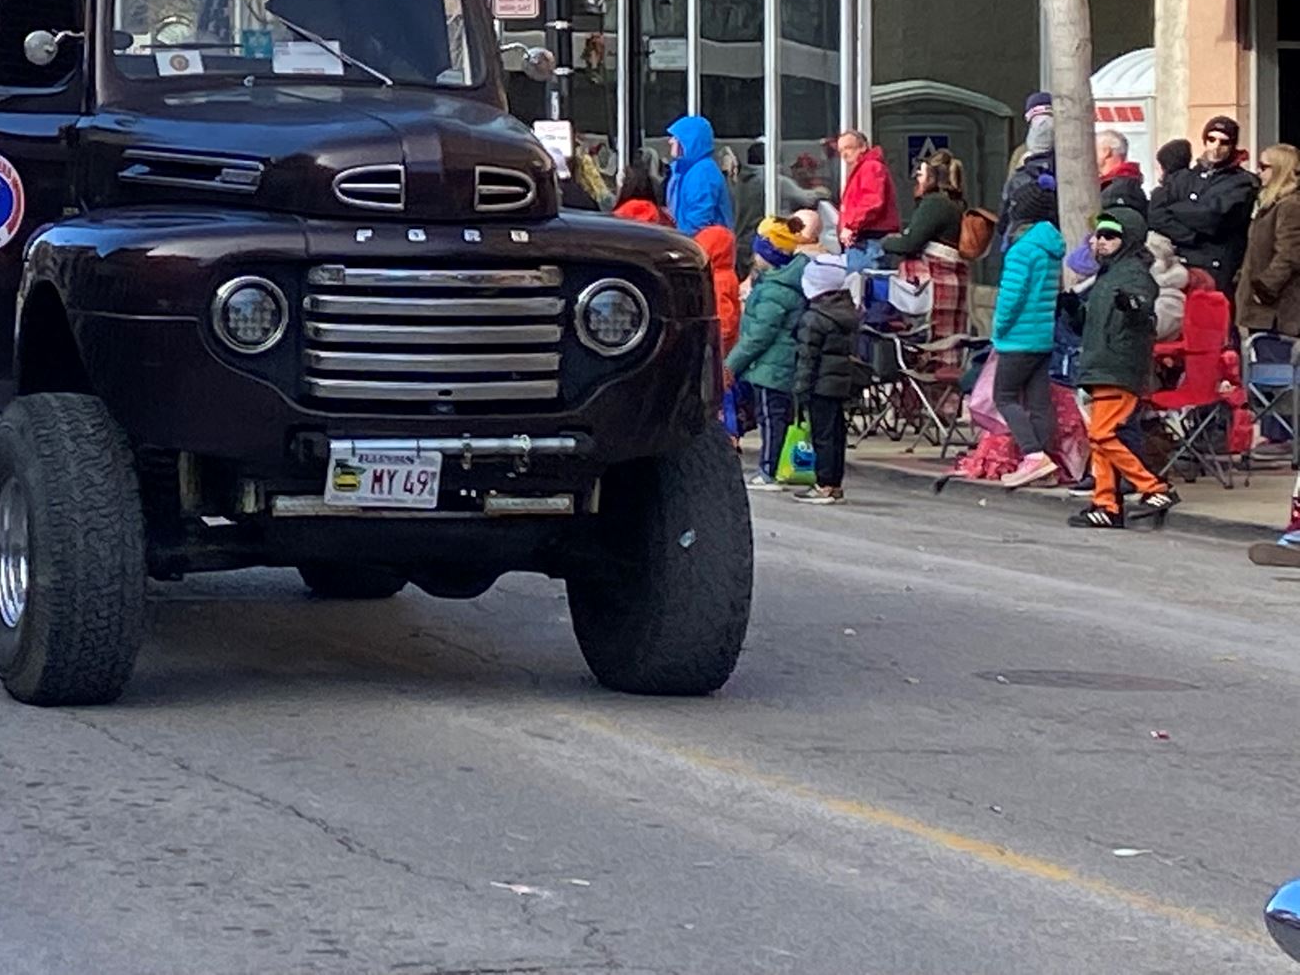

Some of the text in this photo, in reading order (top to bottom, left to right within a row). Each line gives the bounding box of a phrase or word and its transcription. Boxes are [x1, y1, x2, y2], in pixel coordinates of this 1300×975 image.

[355, 228, 530, 243] FORD
[370, 468, 399, 496] MY
[403, 469, 430, 497] 49
